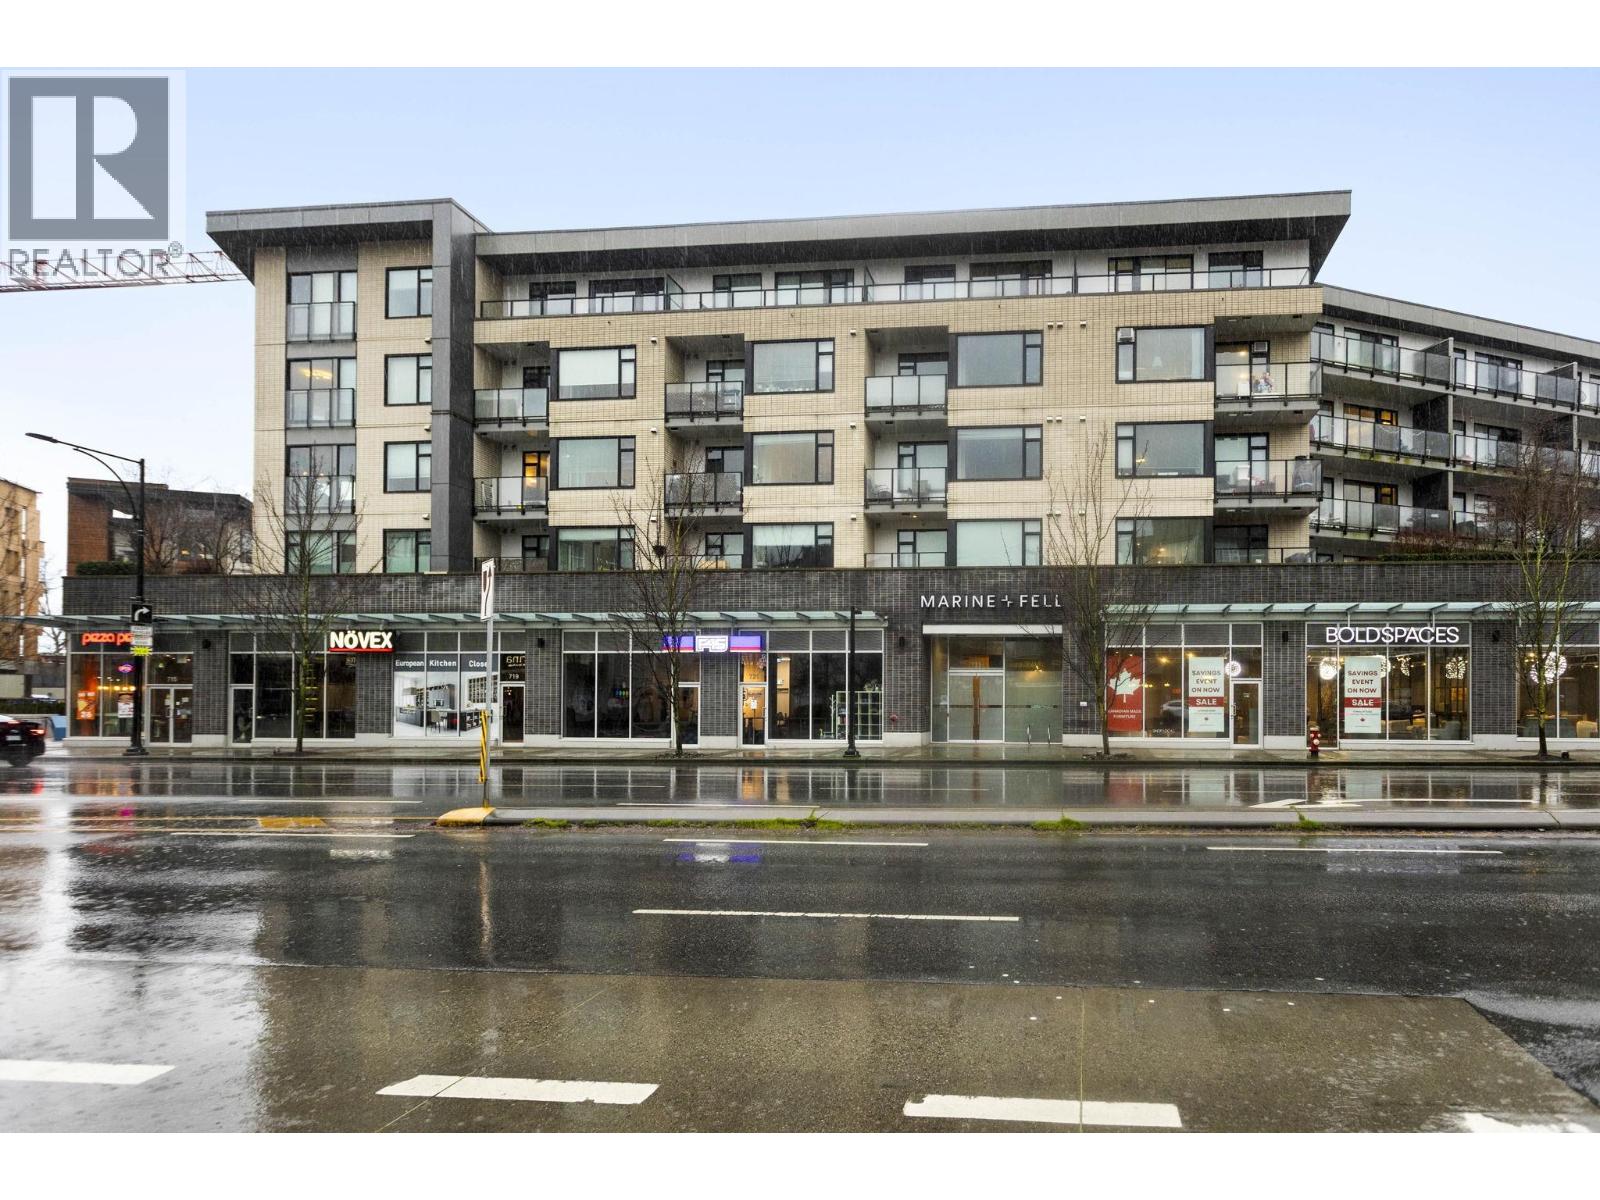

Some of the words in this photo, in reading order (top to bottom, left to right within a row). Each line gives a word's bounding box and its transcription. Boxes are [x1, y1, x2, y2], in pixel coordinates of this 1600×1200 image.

[920, 594, 996, 608] MARINE
[1019, 594, 1063, 608] FELL
[81, 632, 115, 646] pizza
[329, 630, 393, 649] NÖVEX
[1325, 626, 1460, 643] BOLDSPACES
[395, 659, 425, 668] European
[429, 659, 457, 667] Kitchen
[1195, 698, 1217, 706] SALE
